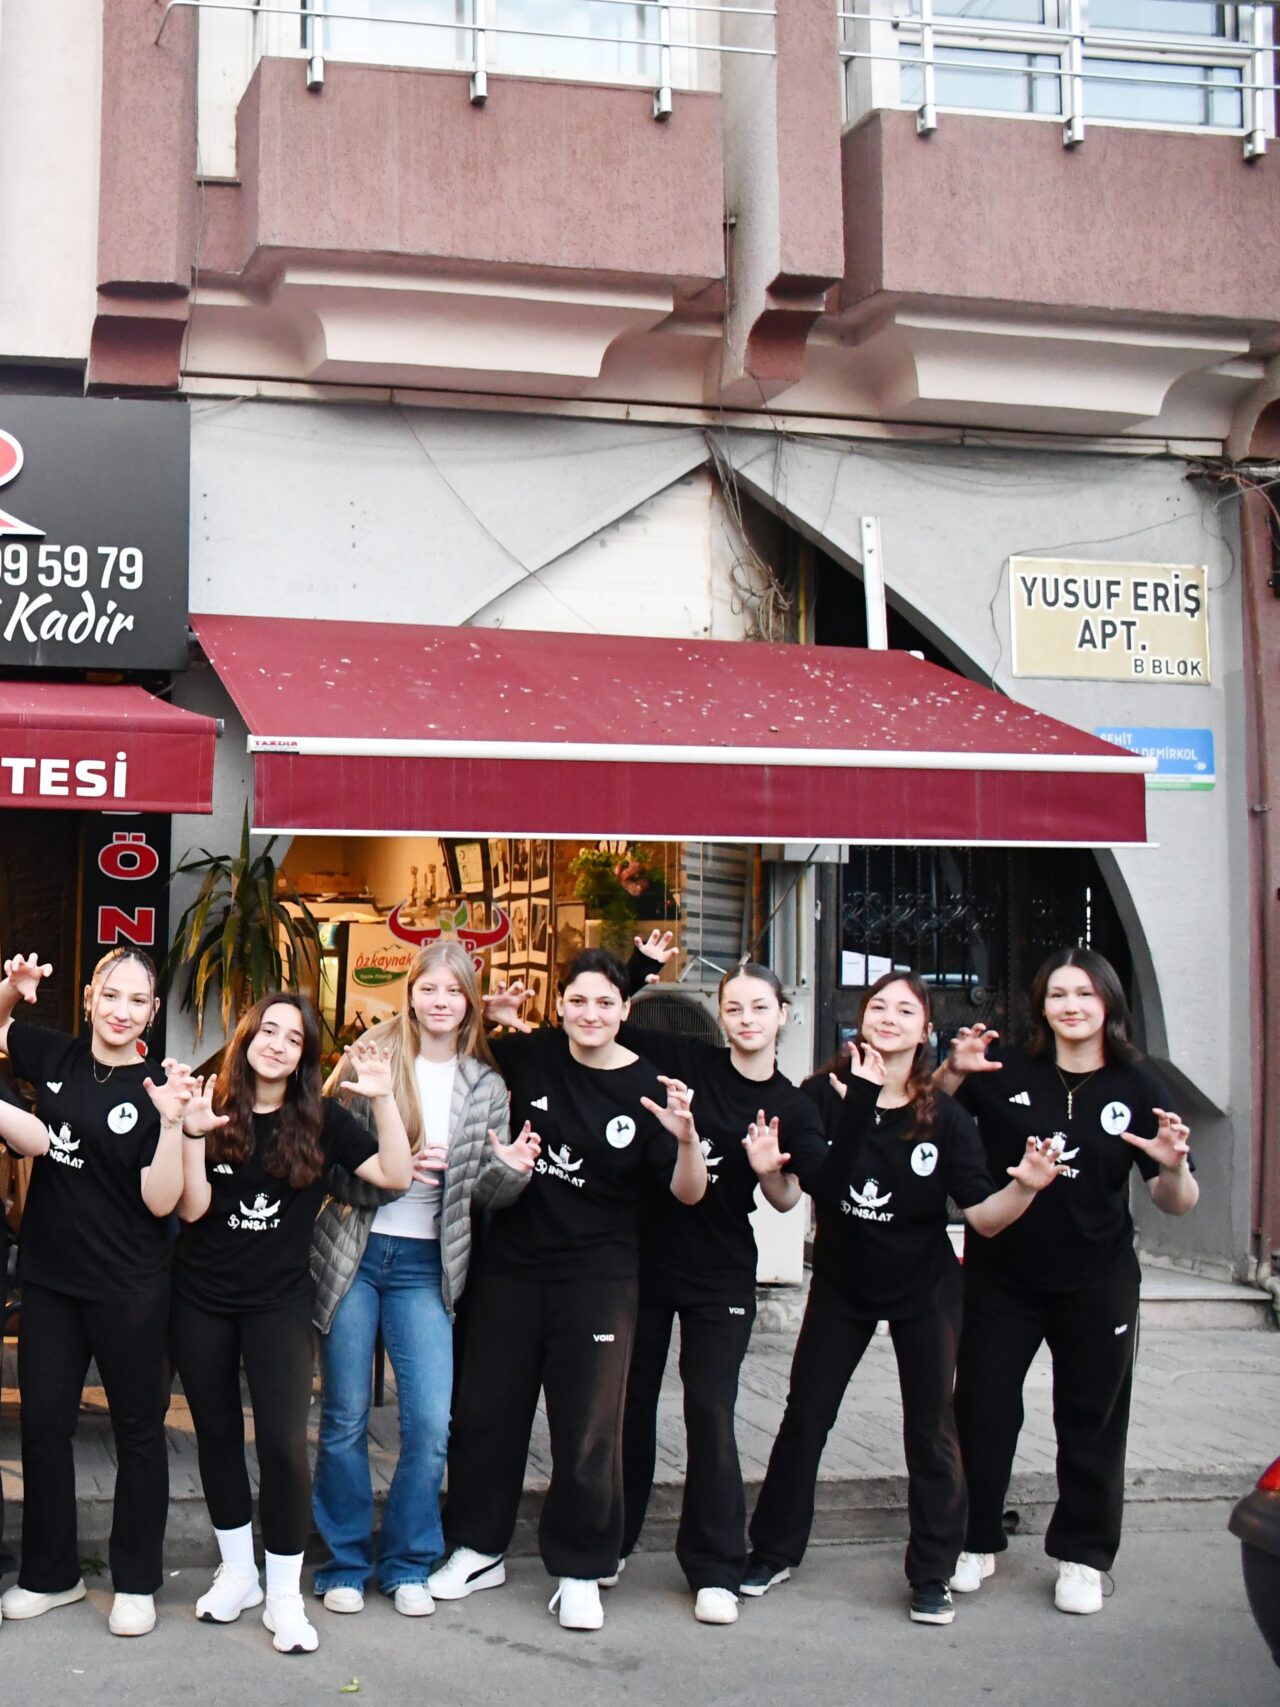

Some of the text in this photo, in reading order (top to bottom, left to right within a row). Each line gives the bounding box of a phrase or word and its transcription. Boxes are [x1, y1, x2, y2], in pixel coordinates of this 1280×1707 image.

[37, 544, 88, 588] 59
[97, 546, 144, 590] 79
[1020, 573, 1201, 618] YUSUF ERİŞ
[3, 589, 135, 645] Kadir
[1077, 619, 1147, 651] APT.
[1133, 658, 1202, 676] B BLOK
[593, 1333, 615, 1342] VOID
